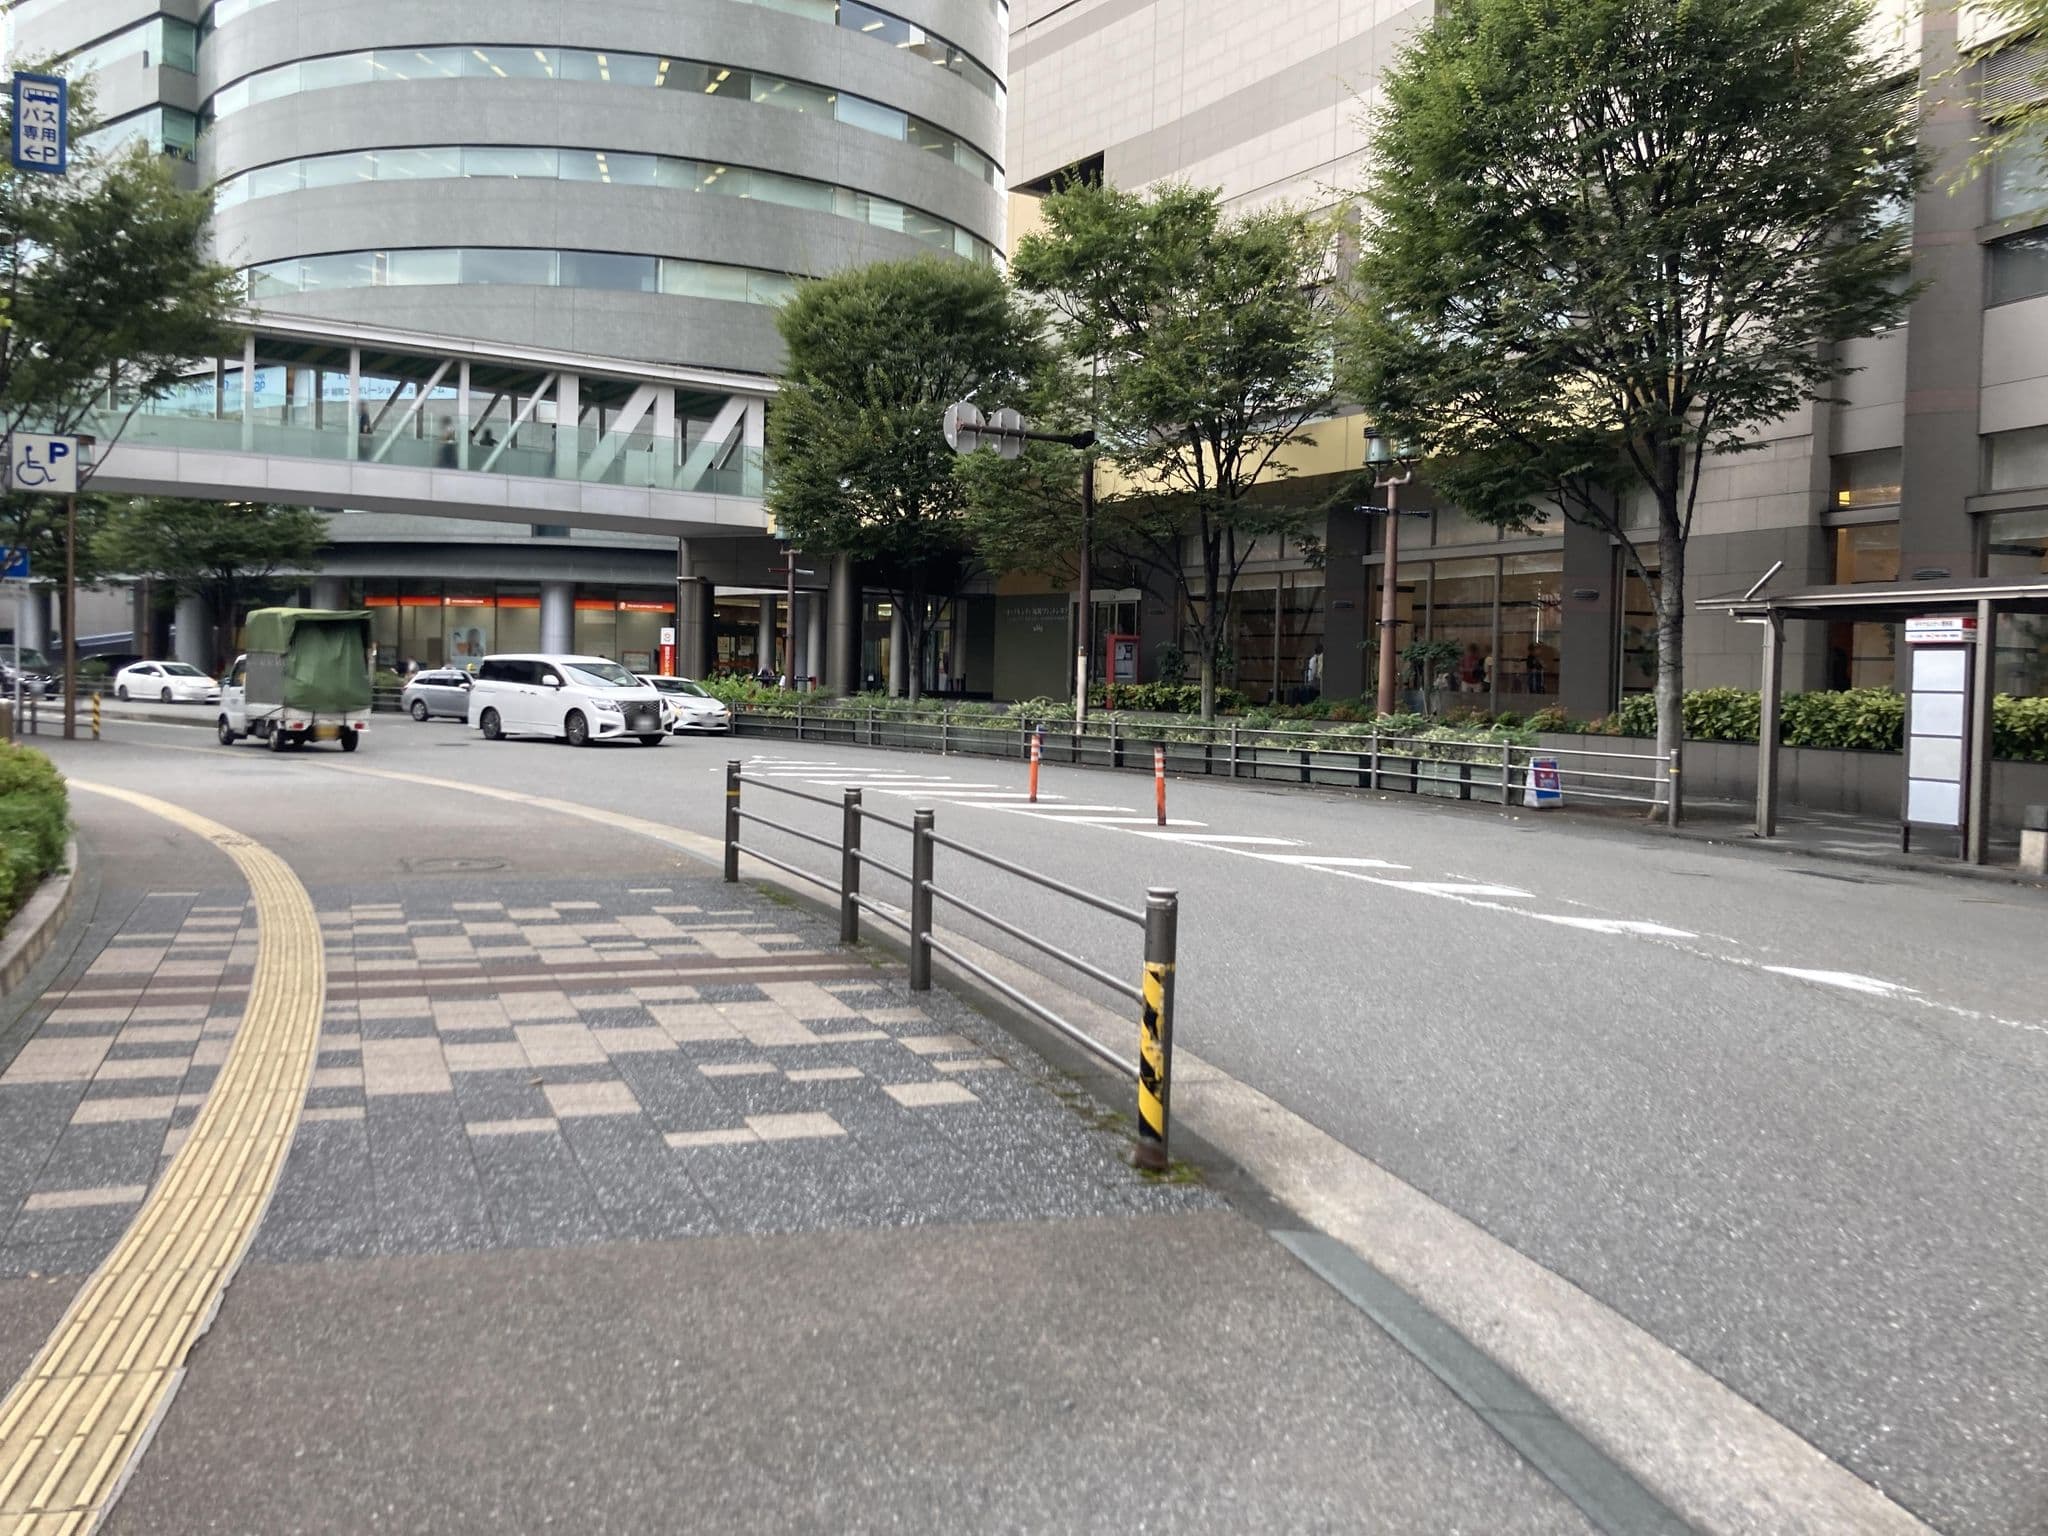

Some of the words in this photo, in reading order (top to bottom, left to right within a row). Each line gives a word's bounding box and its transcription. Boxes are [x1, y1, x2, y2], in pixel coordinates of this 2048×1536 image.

[23, 107, 57, 124] バス
[23, 125, 57, 142] 専用
[42, 146, 57, 162] P
[49, 442, 69, 464] P
